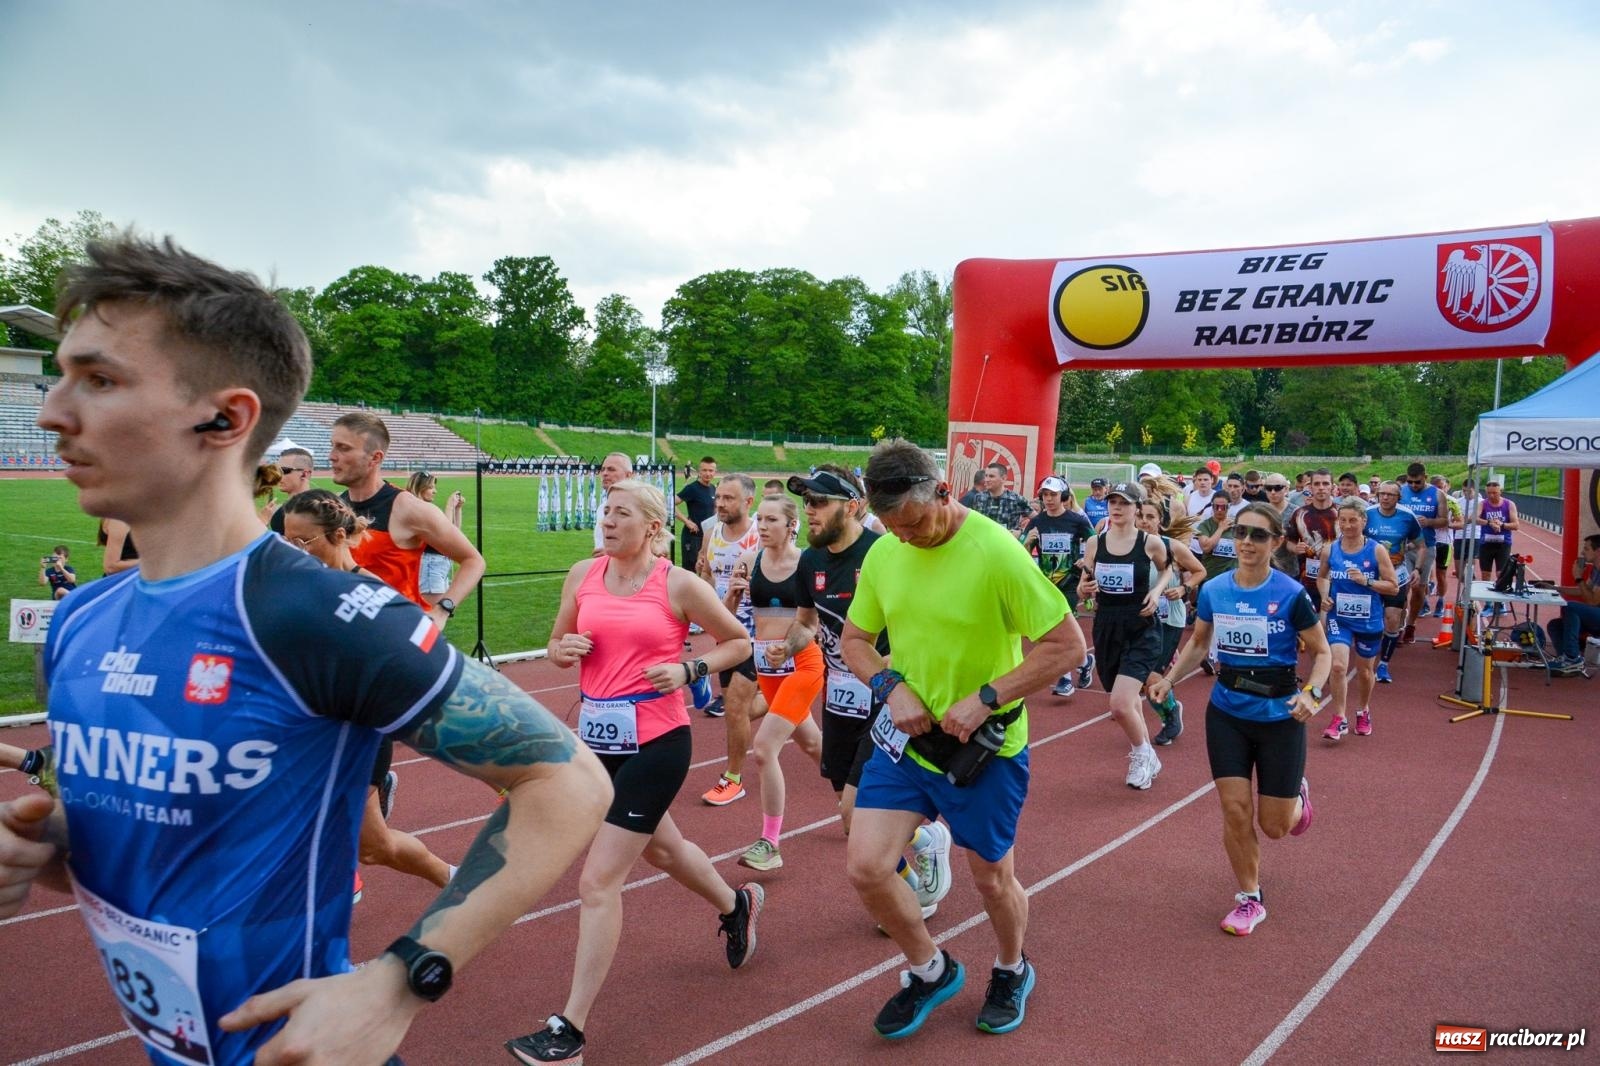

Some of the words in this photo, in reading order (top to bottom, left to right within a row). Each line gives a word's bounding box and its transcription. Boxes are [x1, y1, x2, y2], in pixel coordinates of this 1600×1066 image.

[1238, 252, 1328, 275] BIEG
[1175, 287, 1247, 313] BEZ
[1251, 279, 1394, 309] GRANIC
[1193, 314, 1375, 346] RACIBÓRZ
[1049, 541, 1064, 549] 243
[1220, 545, 1233, 553] 265
[1102, 575, 1123, 586] 252
[1343, 603, 1361, 611] 245
[1226, 630, 1252, 646] 180
[833, 688, 855, 705] 172
[587, 721, 618, 740] 229
[879, 714, 896, 740] 201
[135, 802, 193, 826] TEAM
[123, 919, 181, 947] GRANIC
